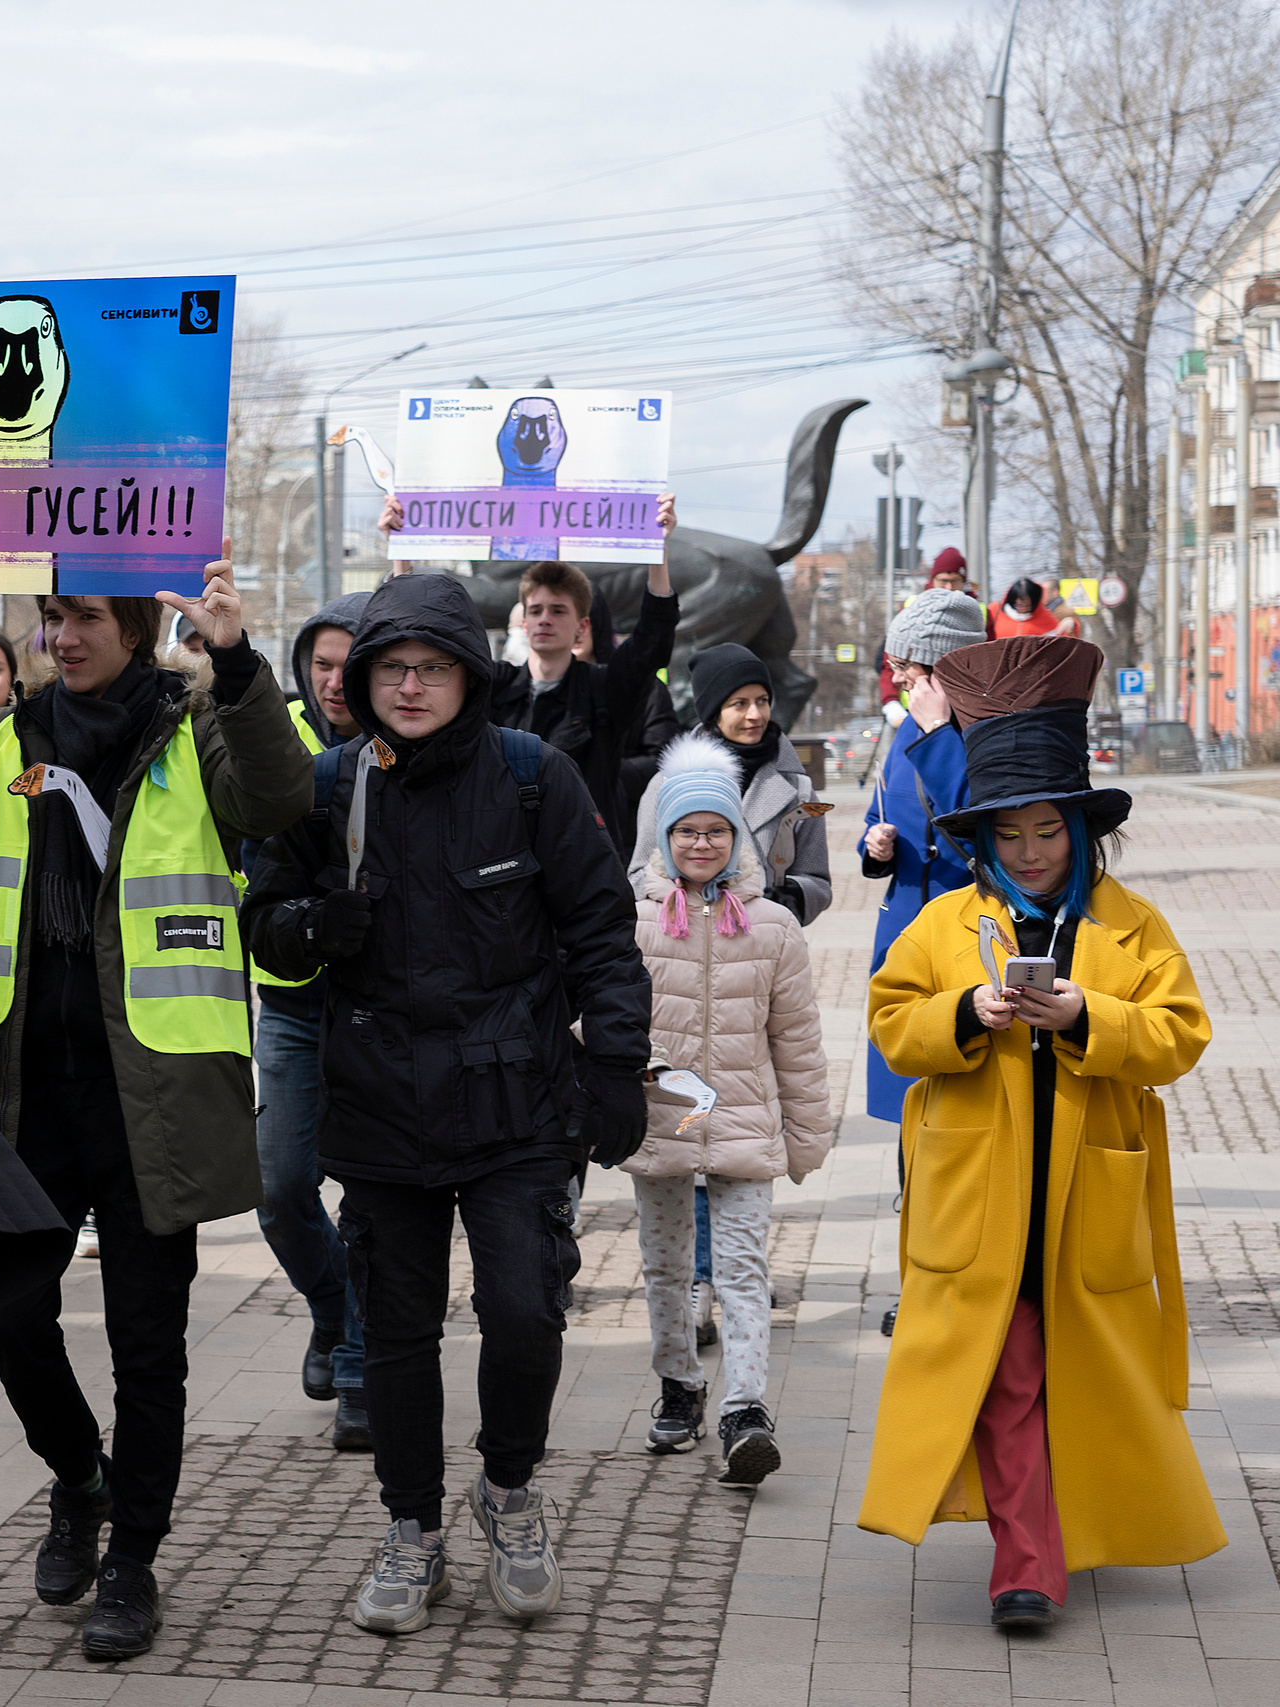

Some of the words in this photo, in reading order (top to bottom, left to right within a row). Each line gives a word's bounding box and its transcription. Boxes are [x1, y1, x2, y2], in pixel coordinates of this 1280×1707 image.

[101, 308, 178, 320] СЕНСИВИТИ
[25, 477, 195, 538] ГУСЕЙ!!!
[408, 500, 515, 529] ОТПУСТИ
[539, 497, 648, 530] ГУСЕЙ!!!
